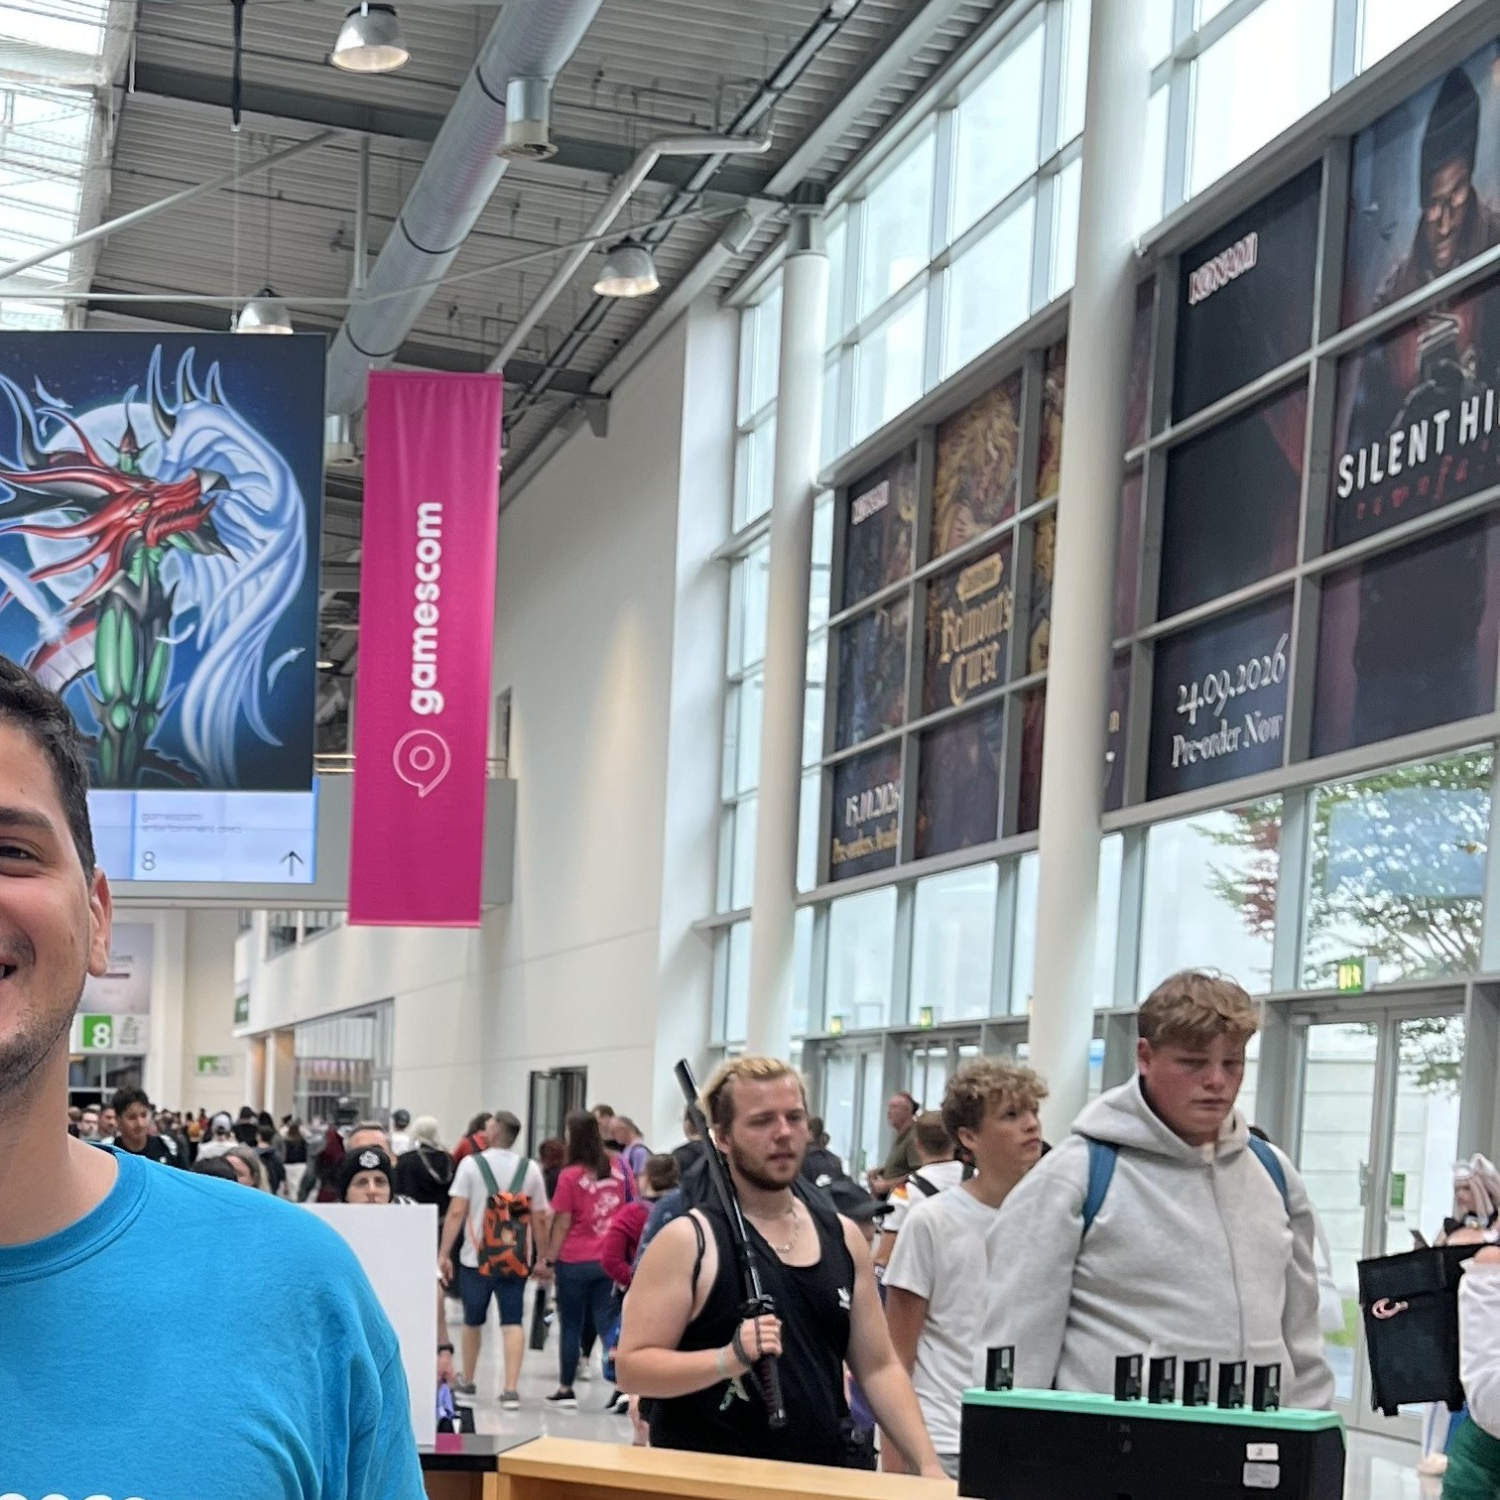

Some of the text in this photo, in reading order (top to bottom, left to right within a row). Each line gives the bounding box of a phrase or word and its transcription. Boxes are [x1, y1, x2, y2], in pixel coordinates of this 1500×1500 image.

[1337, 409, 1450, 498] SILENT
[1459, 388, 1500, 447] HI
[410, 502, 444, 716] gamescom
[1176, 633, 1288, 725] 24.09.2026
[1171, 710, 1283, 768] Pre-order Now
[141, 850, 157, 872] 8
[92, 1022, 112, 1049] 8
